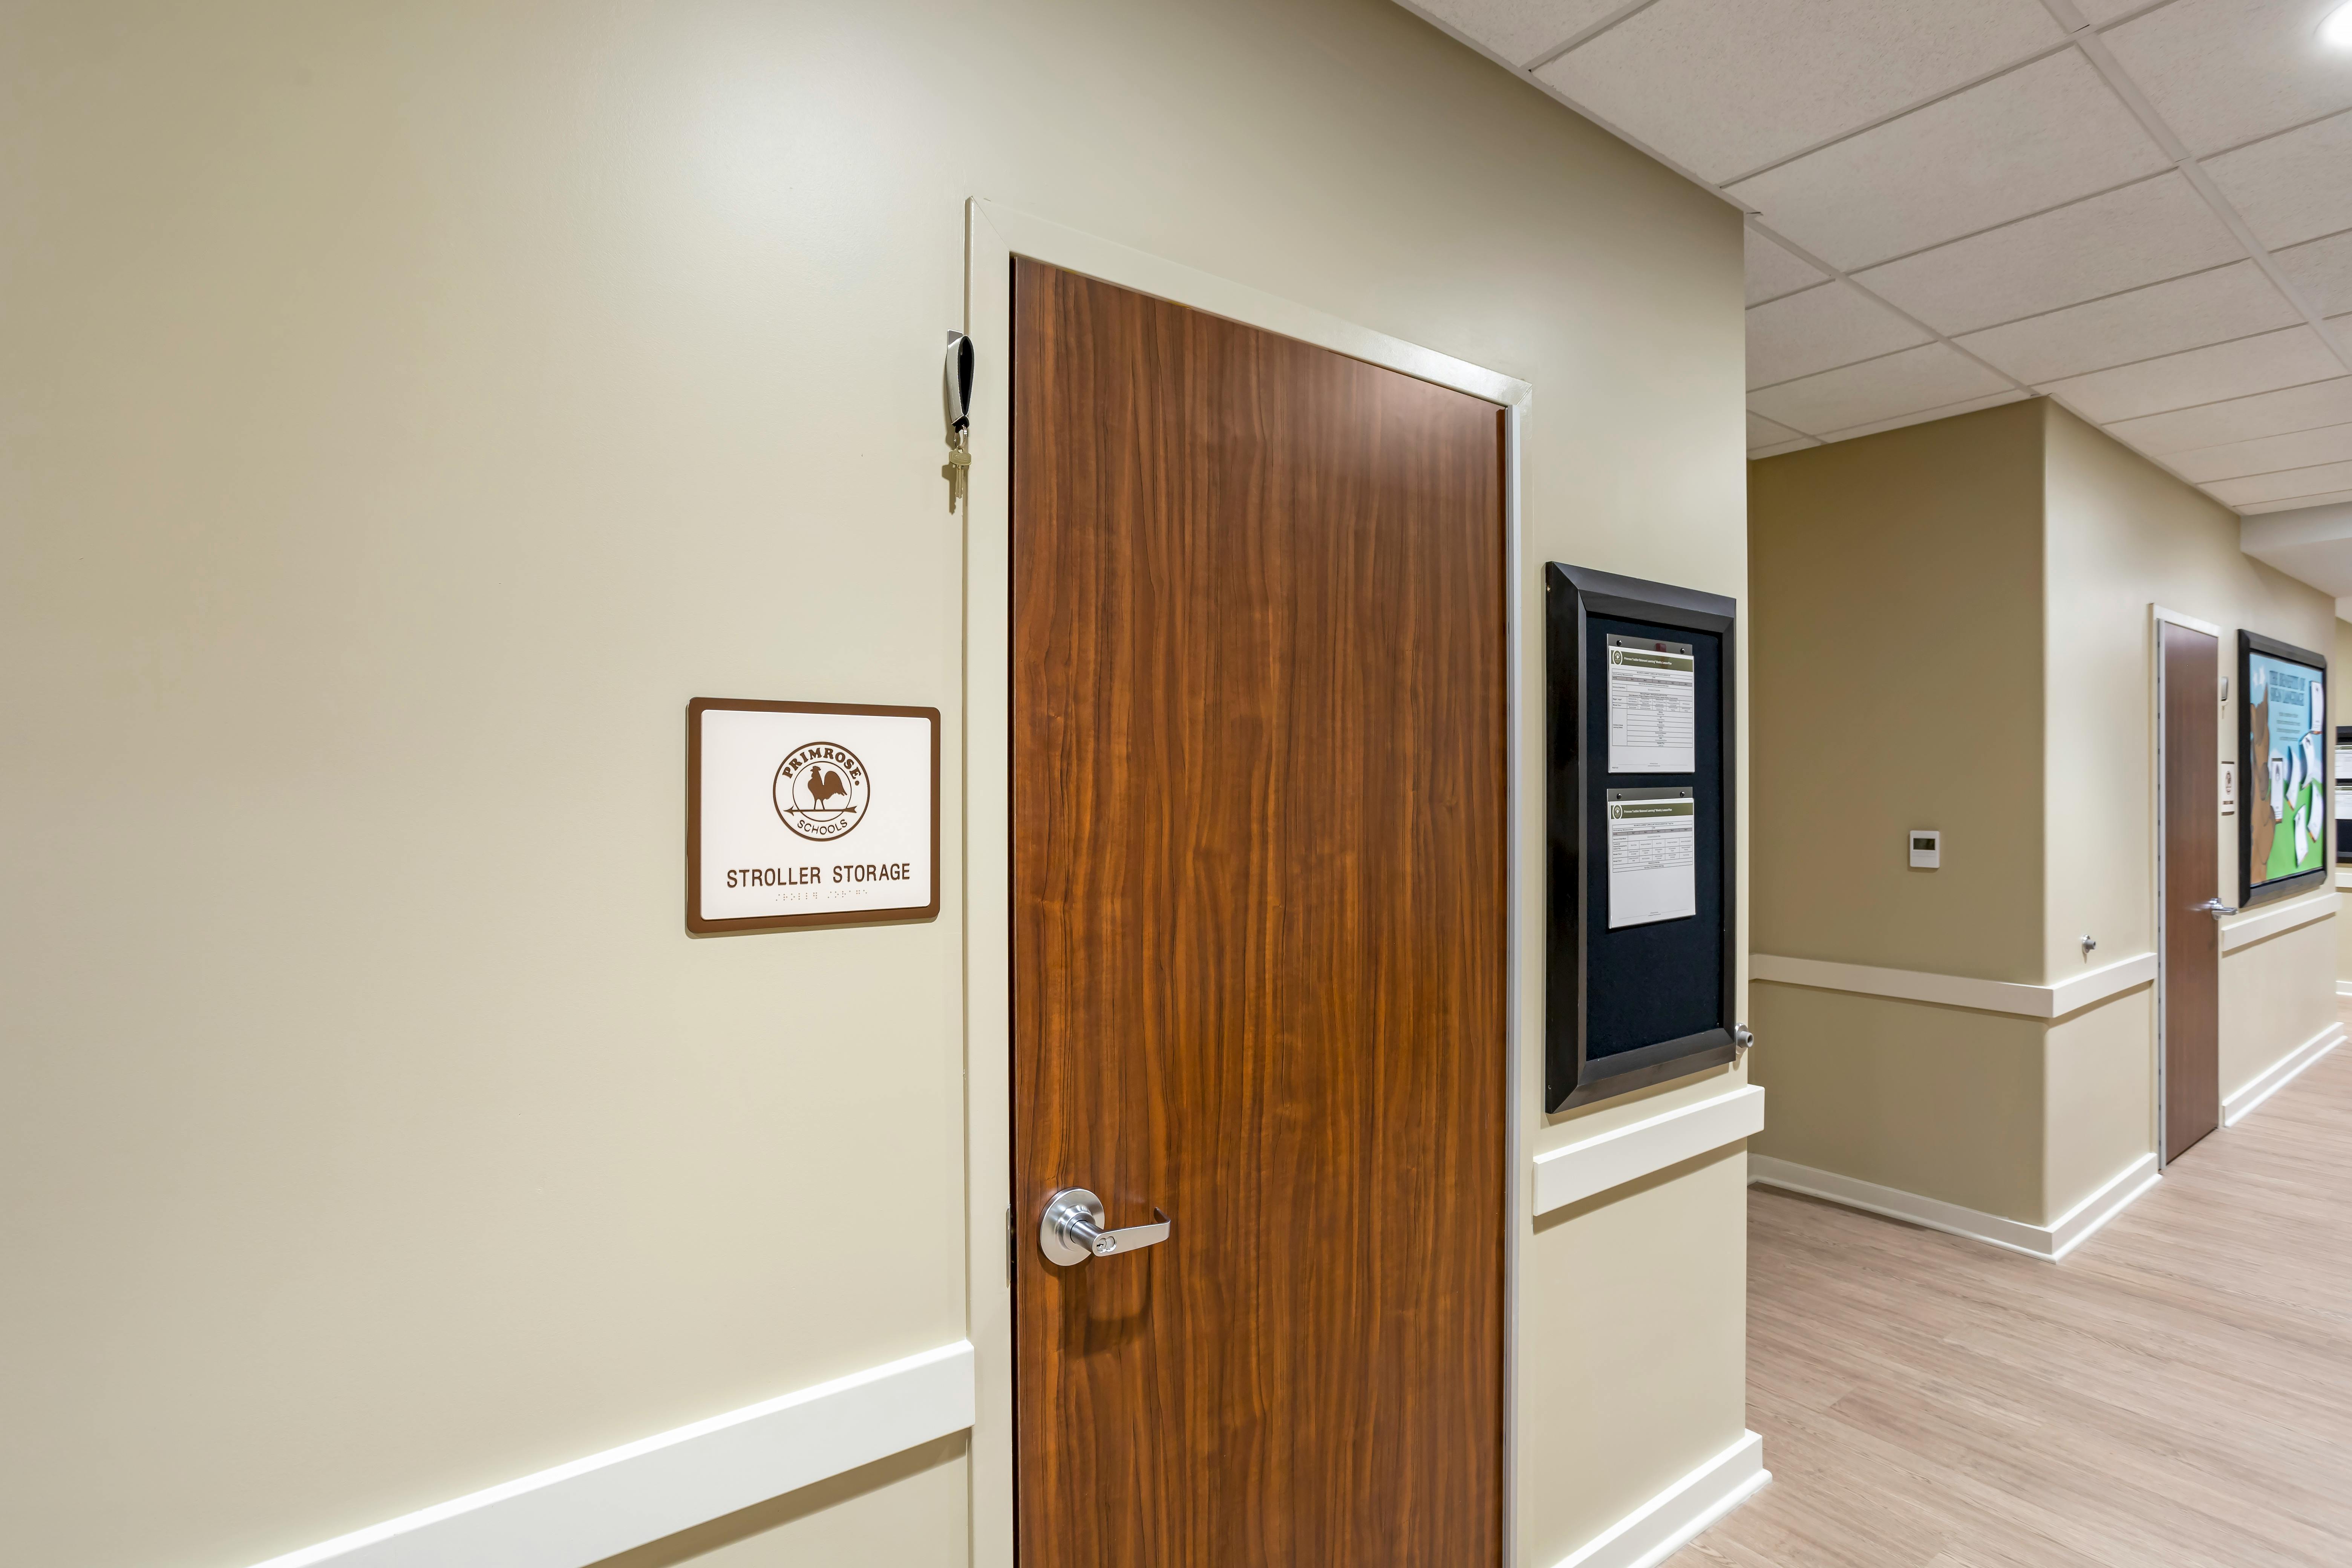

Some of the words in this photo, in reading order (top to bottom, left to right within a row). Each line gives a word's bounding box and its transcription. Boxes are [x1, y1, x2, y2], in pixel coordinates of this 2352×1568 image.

[797, 819, 848, 835] SCHOOLS
[727, 867, 821, 888] STROLLER
[833, 863, 910, 884] STORAGE
